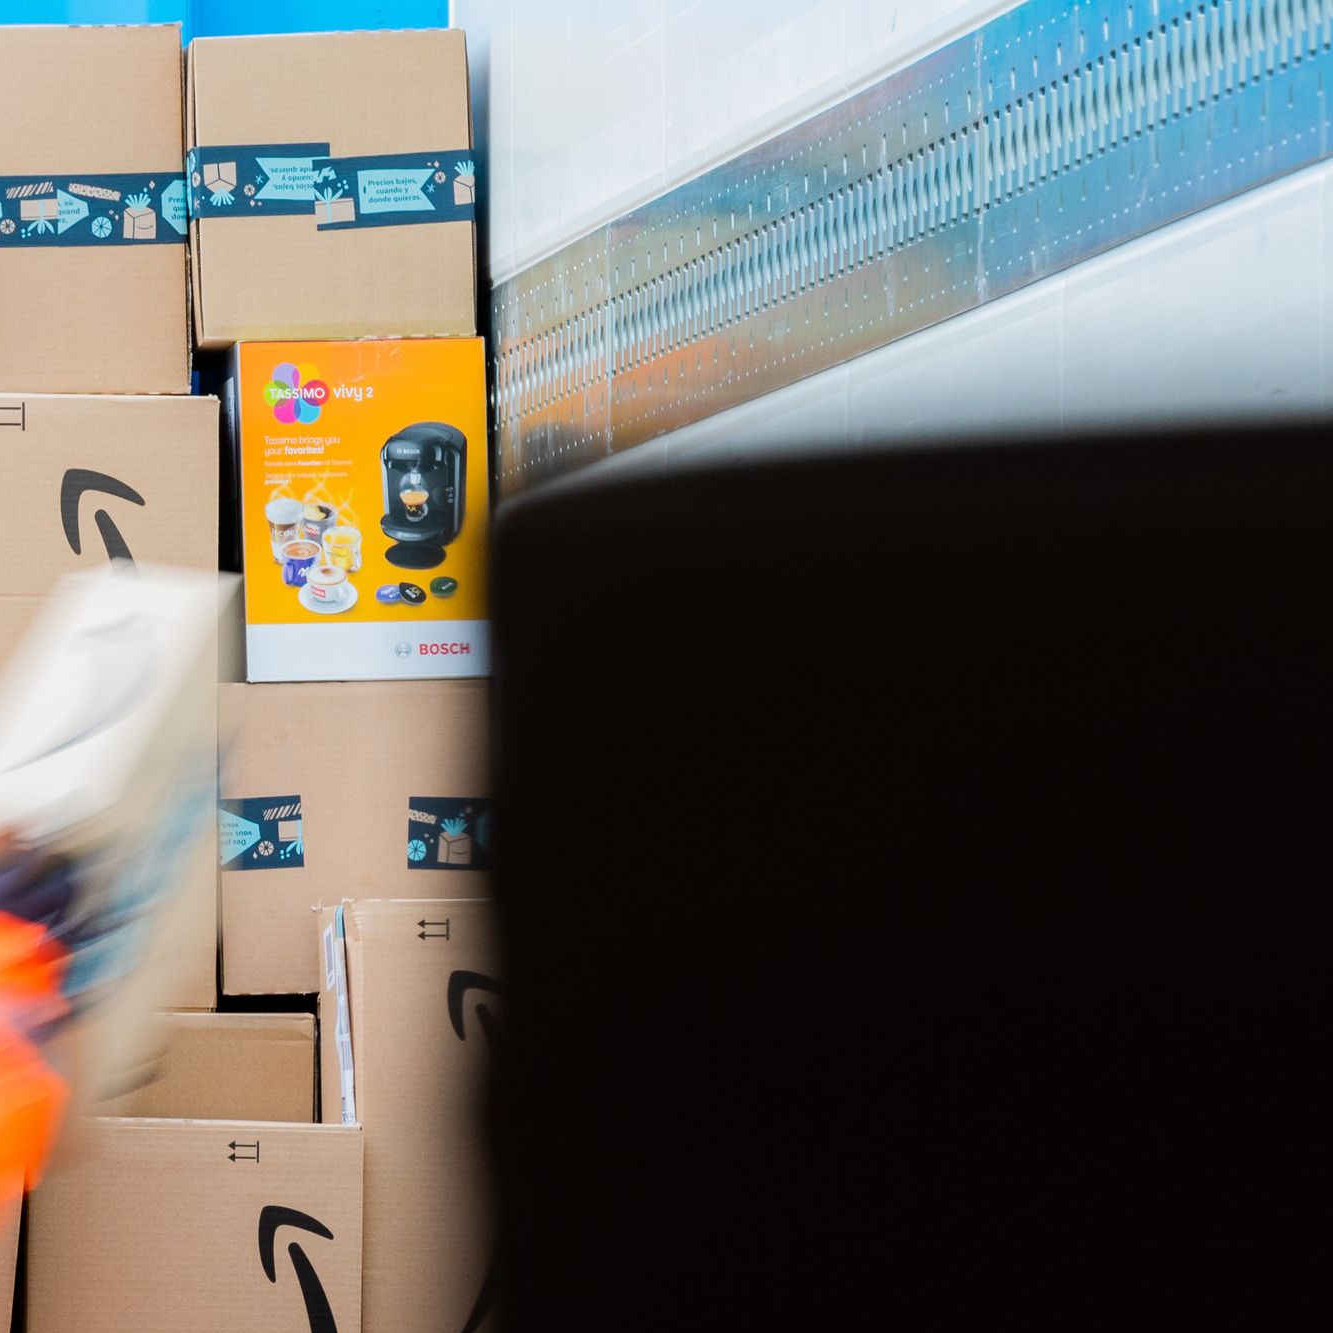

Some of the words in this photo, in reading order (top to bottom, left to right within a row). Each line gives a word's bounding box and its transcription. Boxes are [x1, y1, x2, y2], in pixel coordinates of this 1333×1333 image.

[368, 178, 394, 187] Precios
[394, 176, 417, 186] bajos,
[375, 185, 403, 195] cuando
[403, 185, 409, 194] y
[369, 195, 391, 203] donde
[392, 193, 421, 203] quieras.
[268, 387, 326, 399] TASSIMO
[333, 384, 363, 402] vivy
[365, 387, 374, 398] 2
[264, 435, 297, 445] Tassimo
[299, 435, 323, 446] brings
[325, 436, 341, 446] you
[264, 447, 282, 457] your
[284, 445, 325, 455] favorites!
[419, 642, 471, 655] BOSCH
